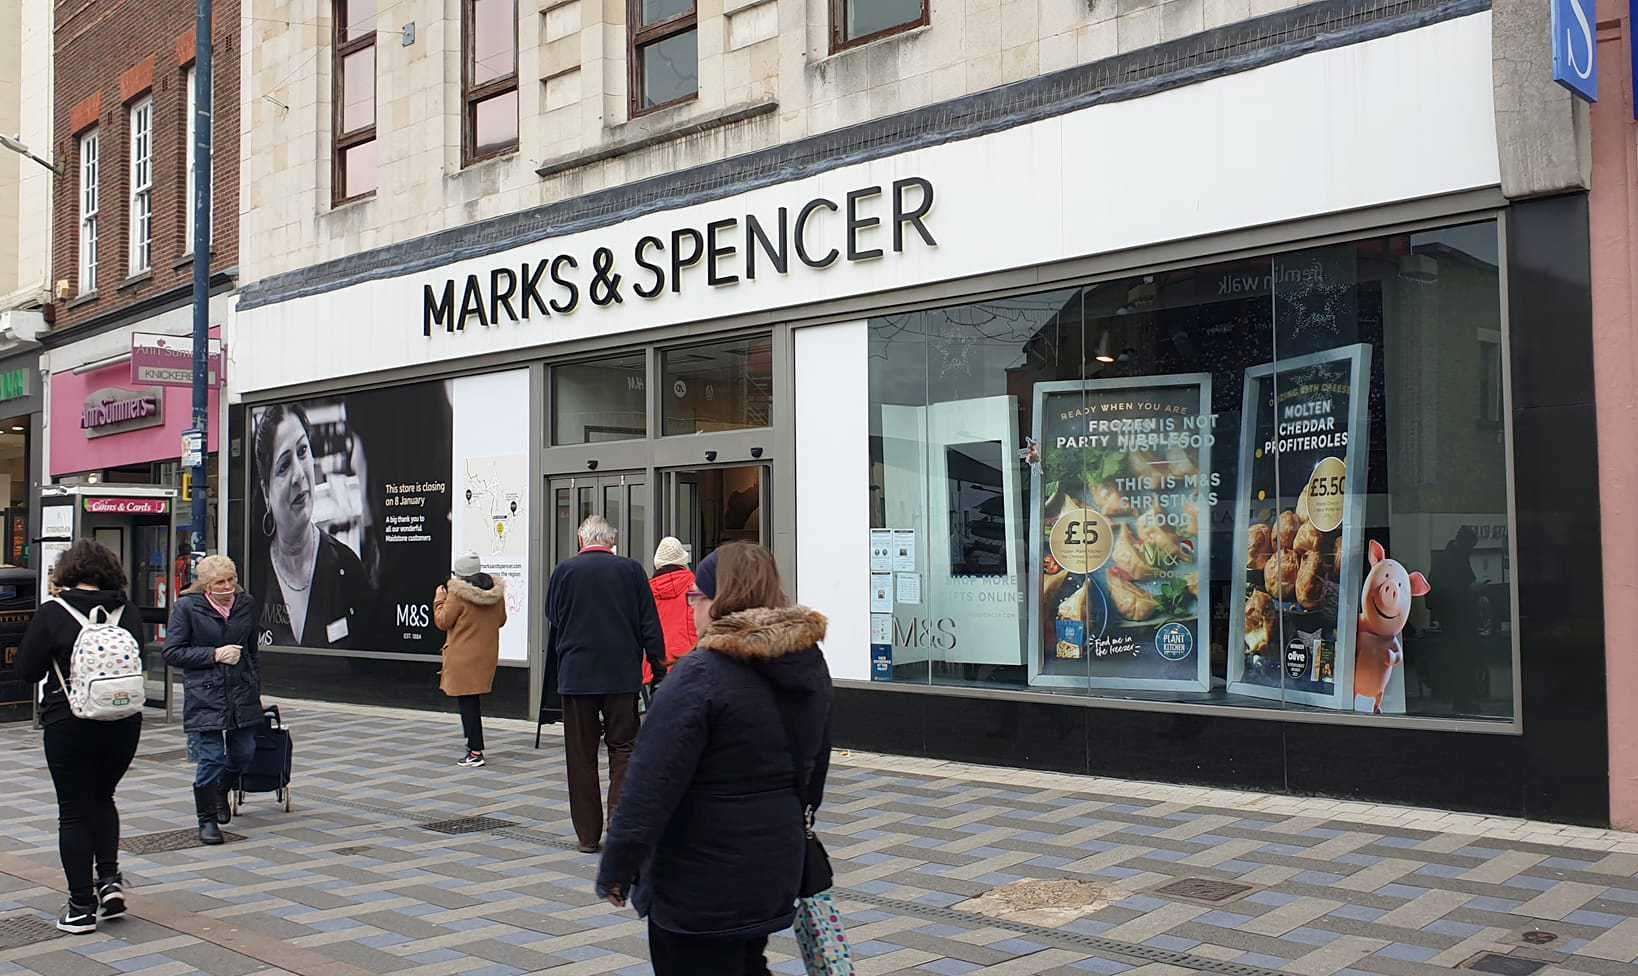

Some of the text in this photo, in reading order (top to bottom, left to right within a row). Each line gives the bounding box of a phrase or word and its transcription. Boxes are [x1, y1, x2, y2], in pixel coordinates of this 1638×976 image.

[423, 176, 937, 337] MARKS & SPENCER
[99, 398, 155, 424] Summers
[1060, 402, 1187, 420] READY WHEN YOU ARE
[1284, 399, 1332, 419] MOLTEN
[1160, 417, 1175, 431] IS
[1183, 414, 1218, 429] NOT
[1279, 416, 1335, 436] CHEDDAR
[1057, 436, 1110, 449] PARTY
[1264, 432, 1348, 454] PROFITEROLES
[385, 480, 445, 493] This store is closing
[1115, 472, 1221, 491] THIS IS M&S
[385, 498, 393, 506] on
[400, 496, 425, 507] January
[1064, 520, 1099, 545] £5
[978, 591, 1024, 603] ONLINE
[396, 603, 429, 628] M&S
[893, 615, 957, 650] M&S
[1163, 634, 1185, 643] PLANT
[1287, 650, 1305, 662] olive
